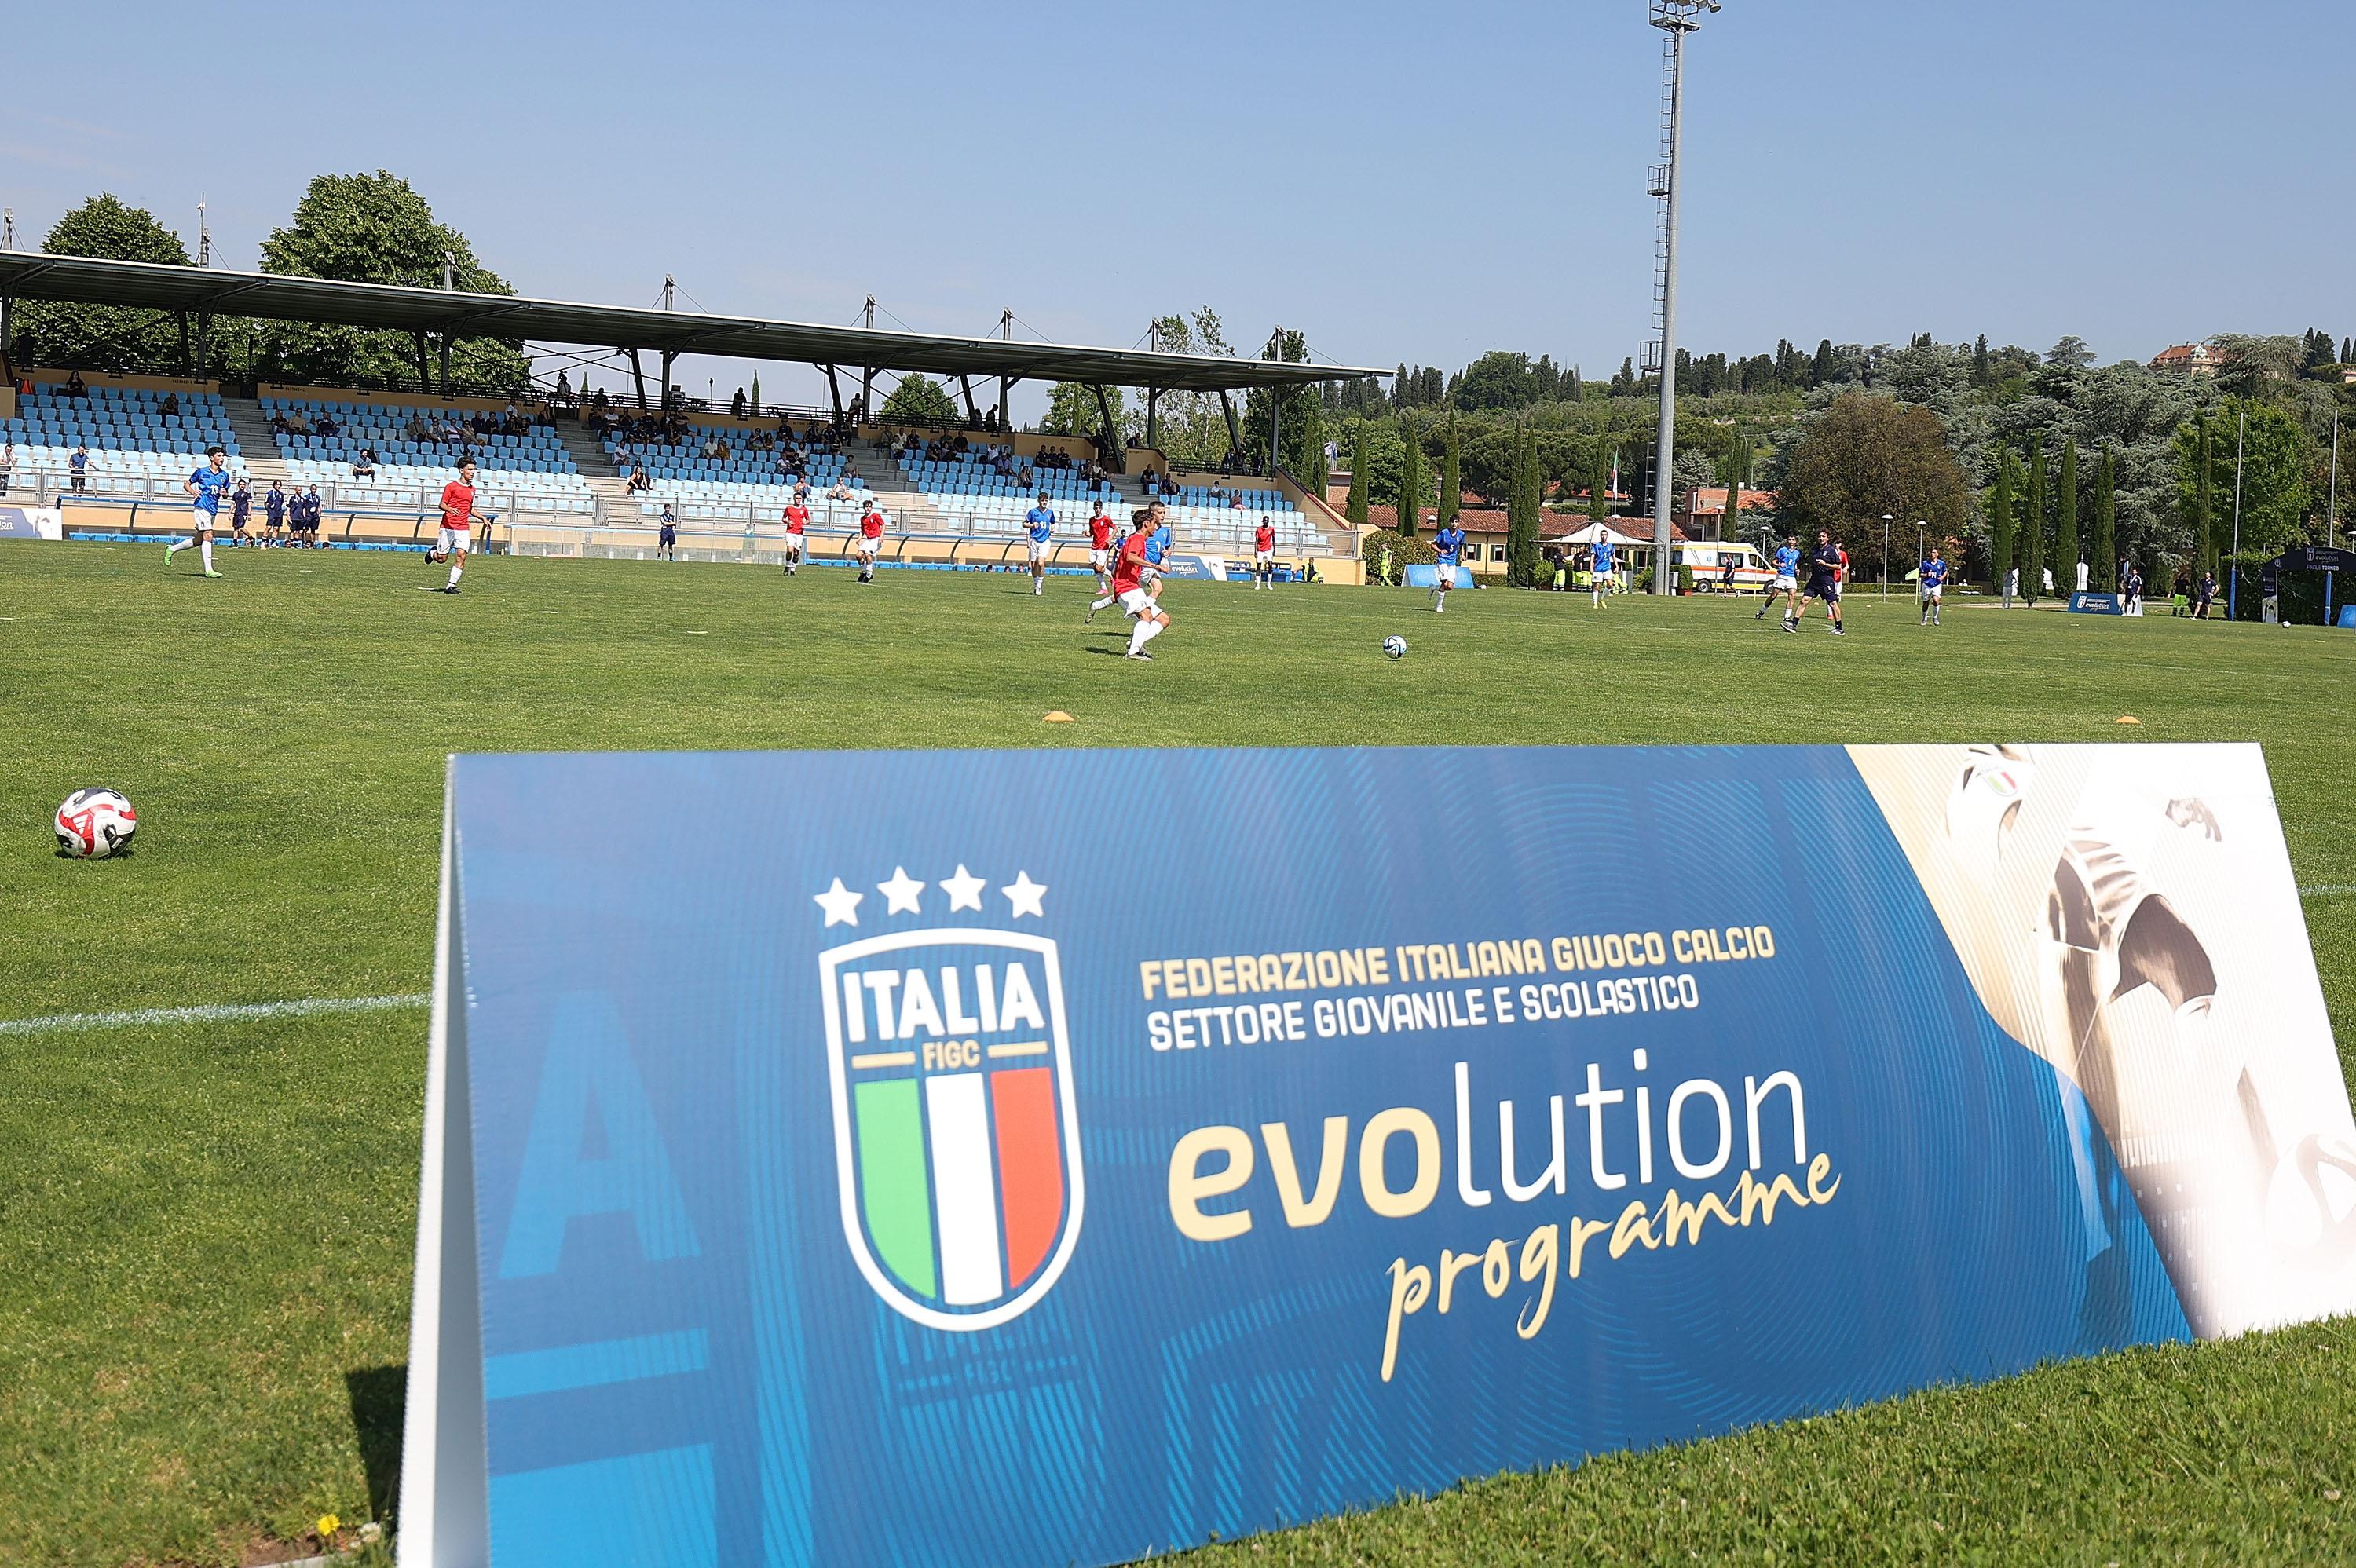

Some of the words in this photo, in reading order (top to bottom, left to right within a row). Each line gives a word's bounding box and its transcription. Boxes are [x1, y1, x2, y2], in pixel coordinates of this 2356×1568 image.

[843, 962, 1046, 1043] ITALIA
[1140, 947, 1390, 1000] FEDERAZIONE
[1396, 938, 1547, 983] ITALIANA
[1551, 931, 1666, 971] GIUOCO
[1672, 925, 1776, 964] CALCIO
[1147, 1000, 1307, 1052] SETTORE
[1312, 989, 1488, 1038] GIOVANILE
[1493, 986, 1516, 1023] E
[1520, 973, 1700, 1022] SCOLASTICO
[922, 1039, 981, 1071] FIGC
[1167, 1047, 1807, 1242] evolution
[1380, 1152, 1842, 1383] programme
